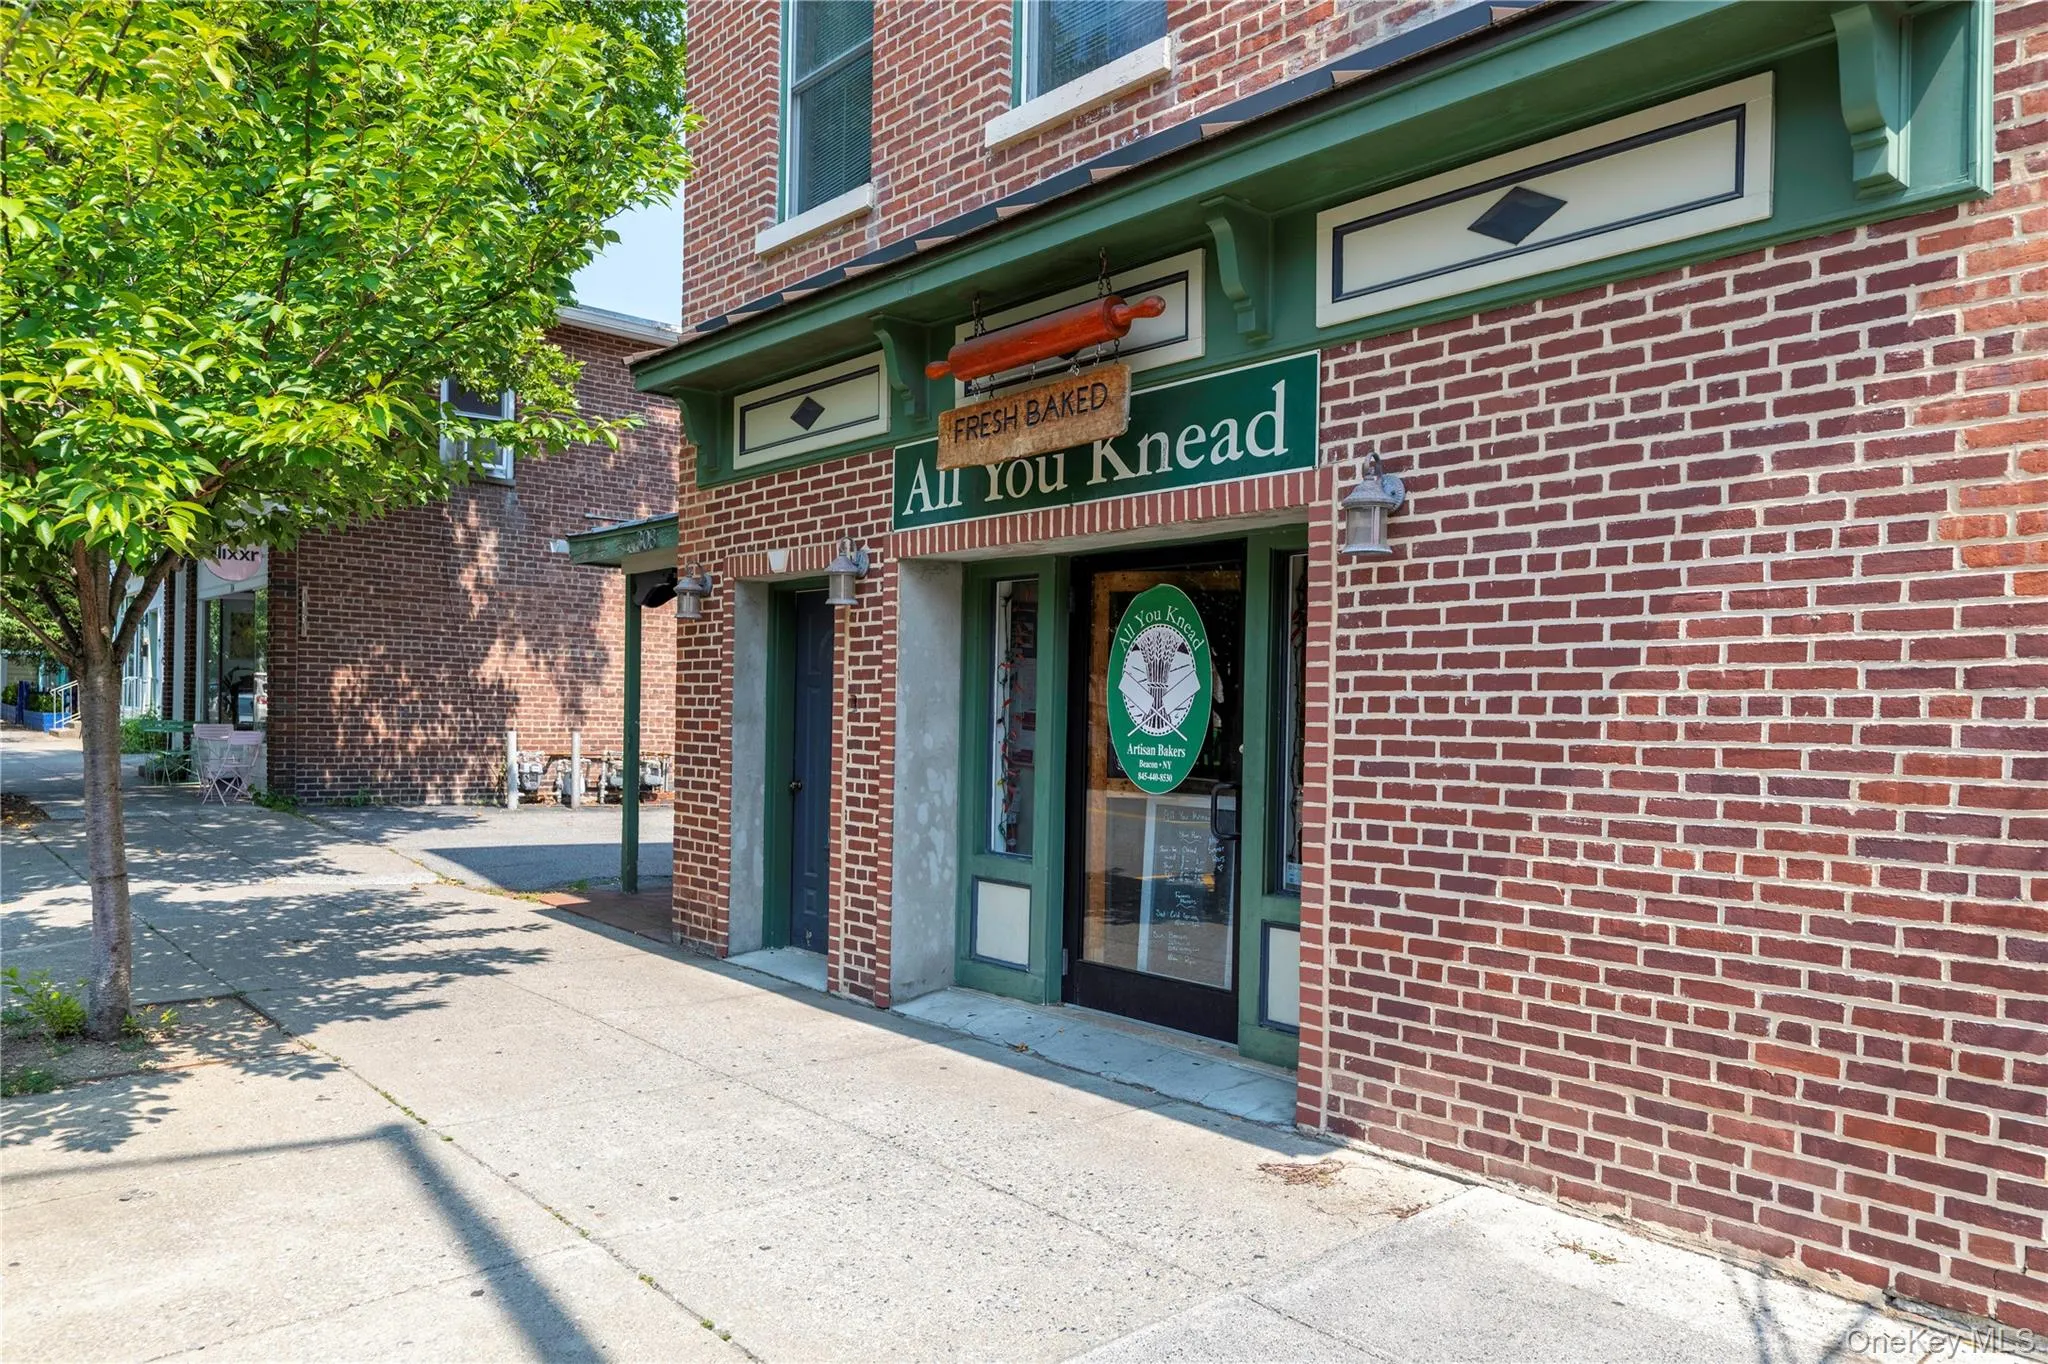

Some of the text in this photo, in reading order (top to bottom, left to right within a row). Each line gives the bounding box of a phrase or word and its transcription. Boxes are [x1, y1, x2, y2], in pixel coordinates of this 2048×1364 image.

[953, 382, 1109, 444] FRESH BAKED
[902, 379, 1290, 517] All You Knead
[217, 543, 260, 562] lixxr
[1119, 604, 1205, 652] All You Knead
[1126, 742, 1186, 758] Artisan Bakers
[1138, 759, 1173, 770] Beacon NY
